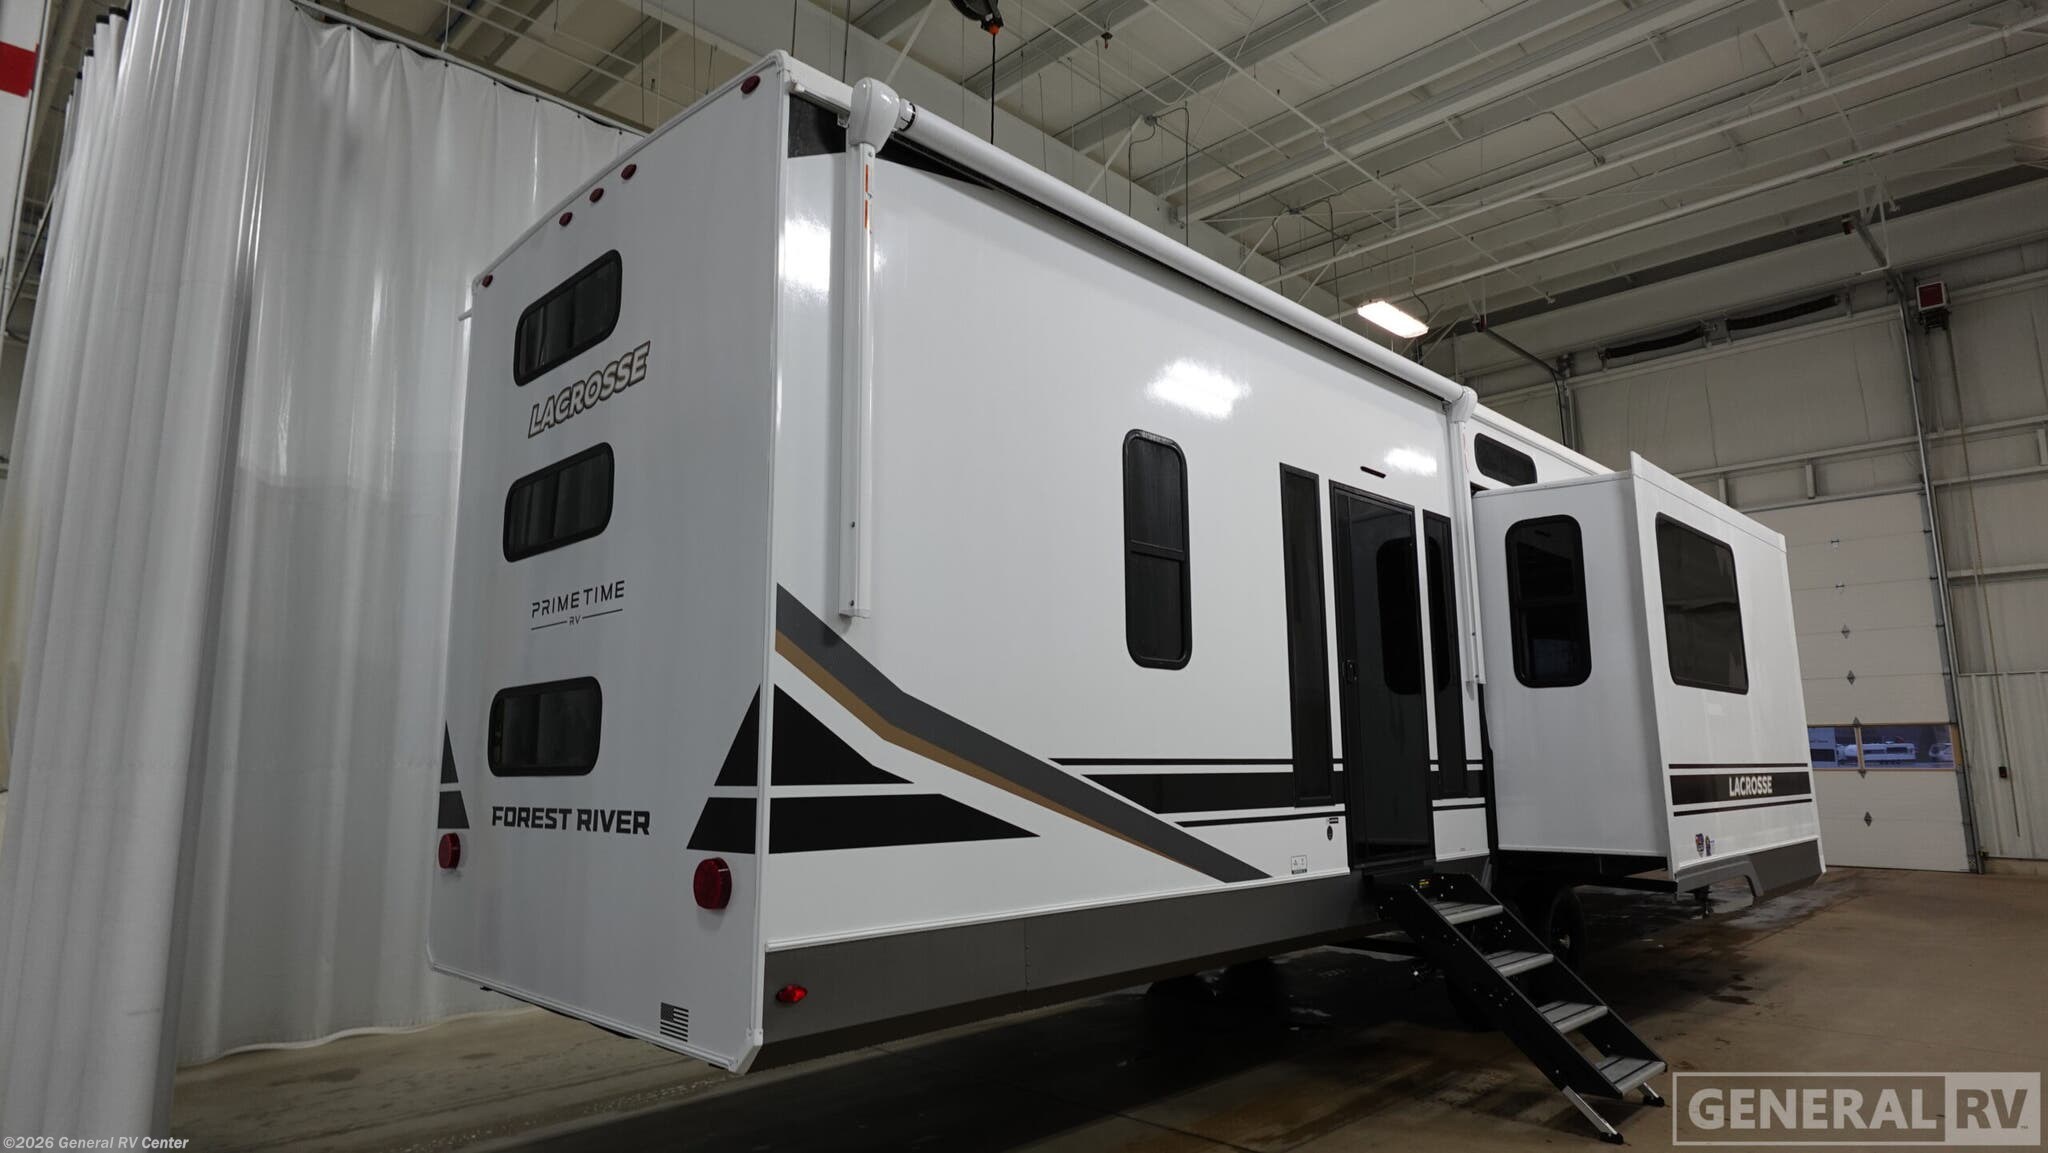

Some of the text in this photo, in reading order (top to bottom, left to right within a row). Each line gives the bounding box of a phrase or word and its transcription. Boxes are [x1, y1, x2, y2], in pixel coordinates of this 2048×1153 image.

[528, 341, 651, 438] LACROSSE
[569, 615, 582, 625] RV
[1728, 775, 1773, 796] LACROSSE
[492, 806, 650, 835] FOREST RIVER
